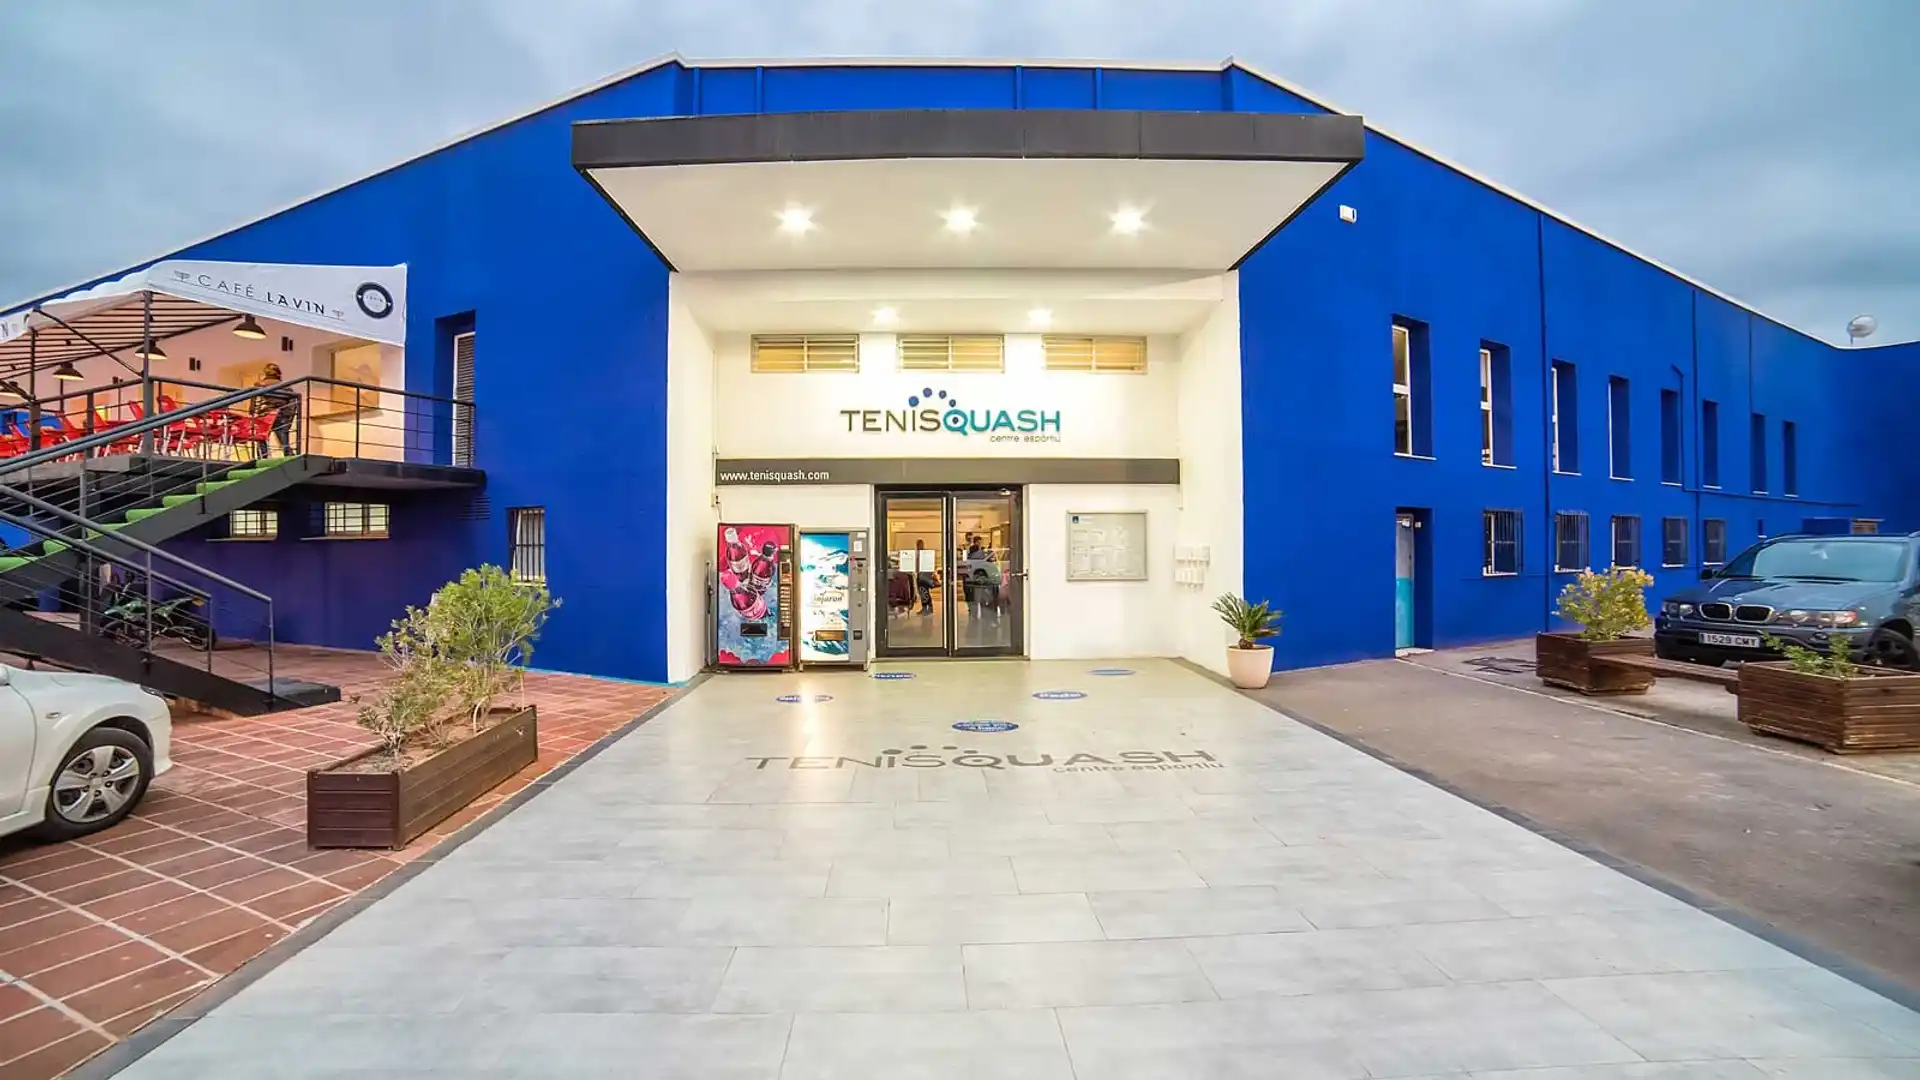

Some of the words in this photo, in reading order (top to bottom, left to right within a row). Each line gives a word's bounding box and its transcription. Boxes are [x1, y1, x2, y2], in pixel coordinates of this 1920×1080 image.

[198, 274, 255, 297] CAFÉ
[267, 291, 325, 315] LAVIN
[989, 435, 1020, 443] centre
[719, 469, 830, 483] www.tenisquash.com
[1052, 764, 1125, 774] centre
